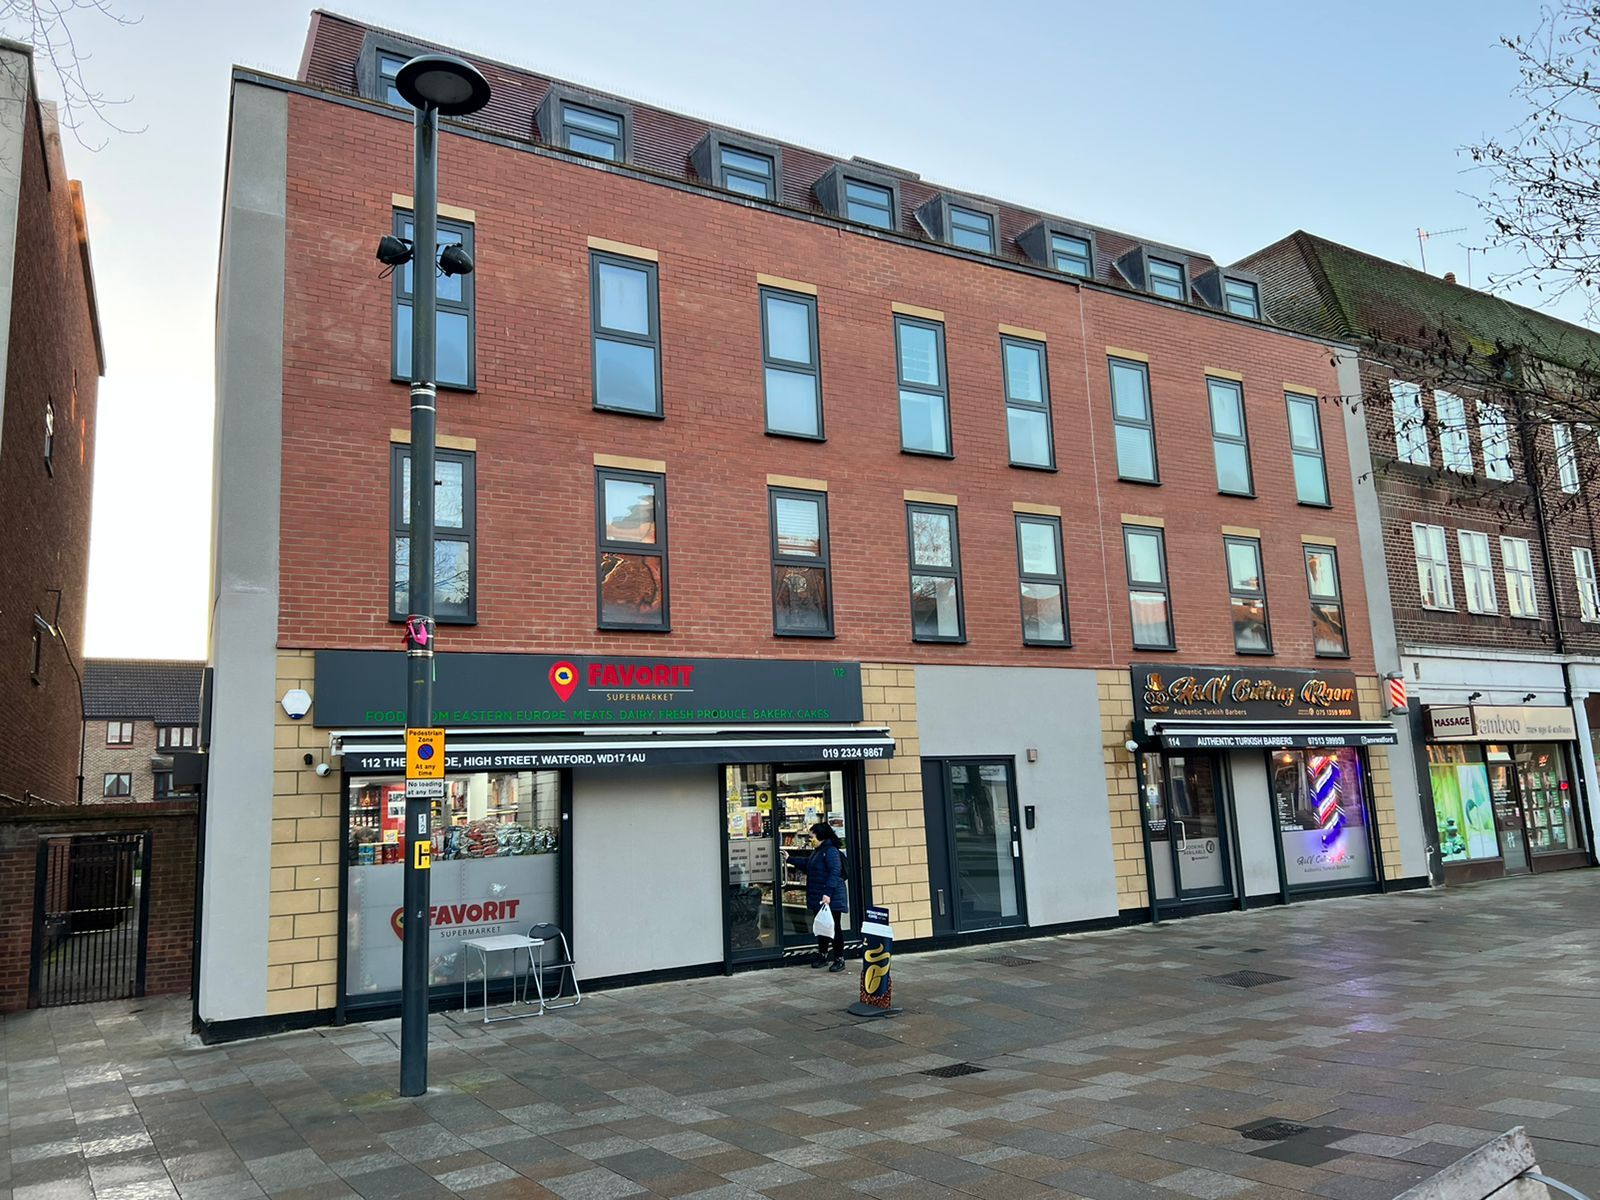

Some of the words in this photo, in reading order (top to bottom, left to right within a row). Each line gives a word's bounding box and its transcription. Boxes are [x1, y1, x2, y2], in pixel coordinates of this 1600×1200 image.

[588, 663, 695, 687] FAVORIT
[607, 693, 674, 702] SUPERMARKET
[1301, 679, 1355, 707] Room
[454, 710, 513, 721] EASTERN
[659, 709, 694, 720] FRESH
[797, 708, 830, 719] CAKES
[1225, 708, 1247, 716] Barbers
[1434, 716, 1470, 727] MASSAGE
[1476, 714, 1520, 735] amboo
[1168, 737, 1180, 746] 114
[1197, 736, 1235, 746] AUTHENTIC
[1235, 736, 1263, 746] TURKISH
[1263, 736, 1293, 746] BARBERS
[361, 758, 381, 768] 112
[383, 757, 406, 768] THE
[463, 756, 492, 767] HIGH
[494, 755, 539, 766] STREET,
[541, 754, 596, 765] WATFORD,
[822, 748, 839, 759] 019
[840, 748, 862, 758] 2324
[863, 747, 884, 757] 9867
[429, 899, 520, 927] FAVORIT
[440, 926, 501, 938] SUPERMARKET
